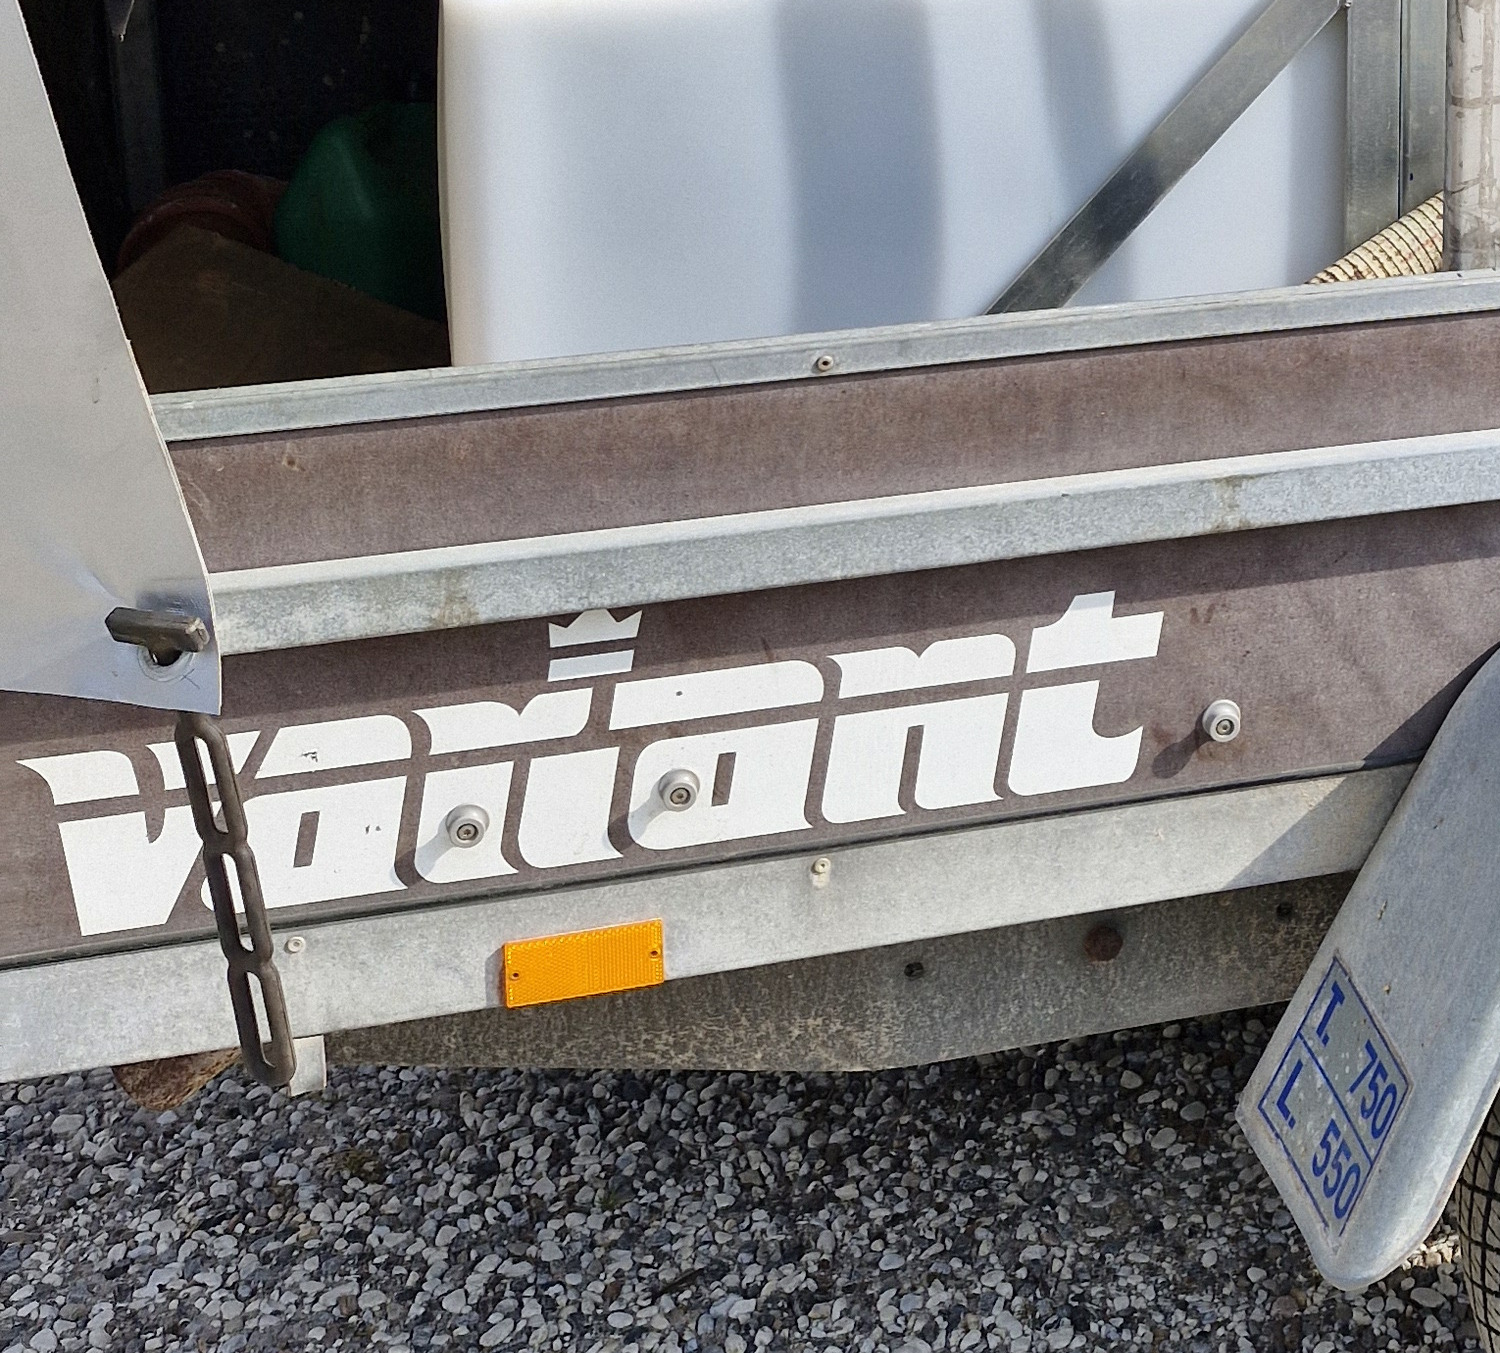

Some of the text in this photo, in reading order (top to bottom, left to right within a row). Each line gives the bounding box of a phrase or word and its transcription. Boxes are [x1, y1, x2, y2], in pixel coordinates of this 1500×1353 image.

[17, 590, 1165, 936] variant
[1350, 1039, 1397, 1140] 750
[1312, 1118, 1361, 1220] 550
